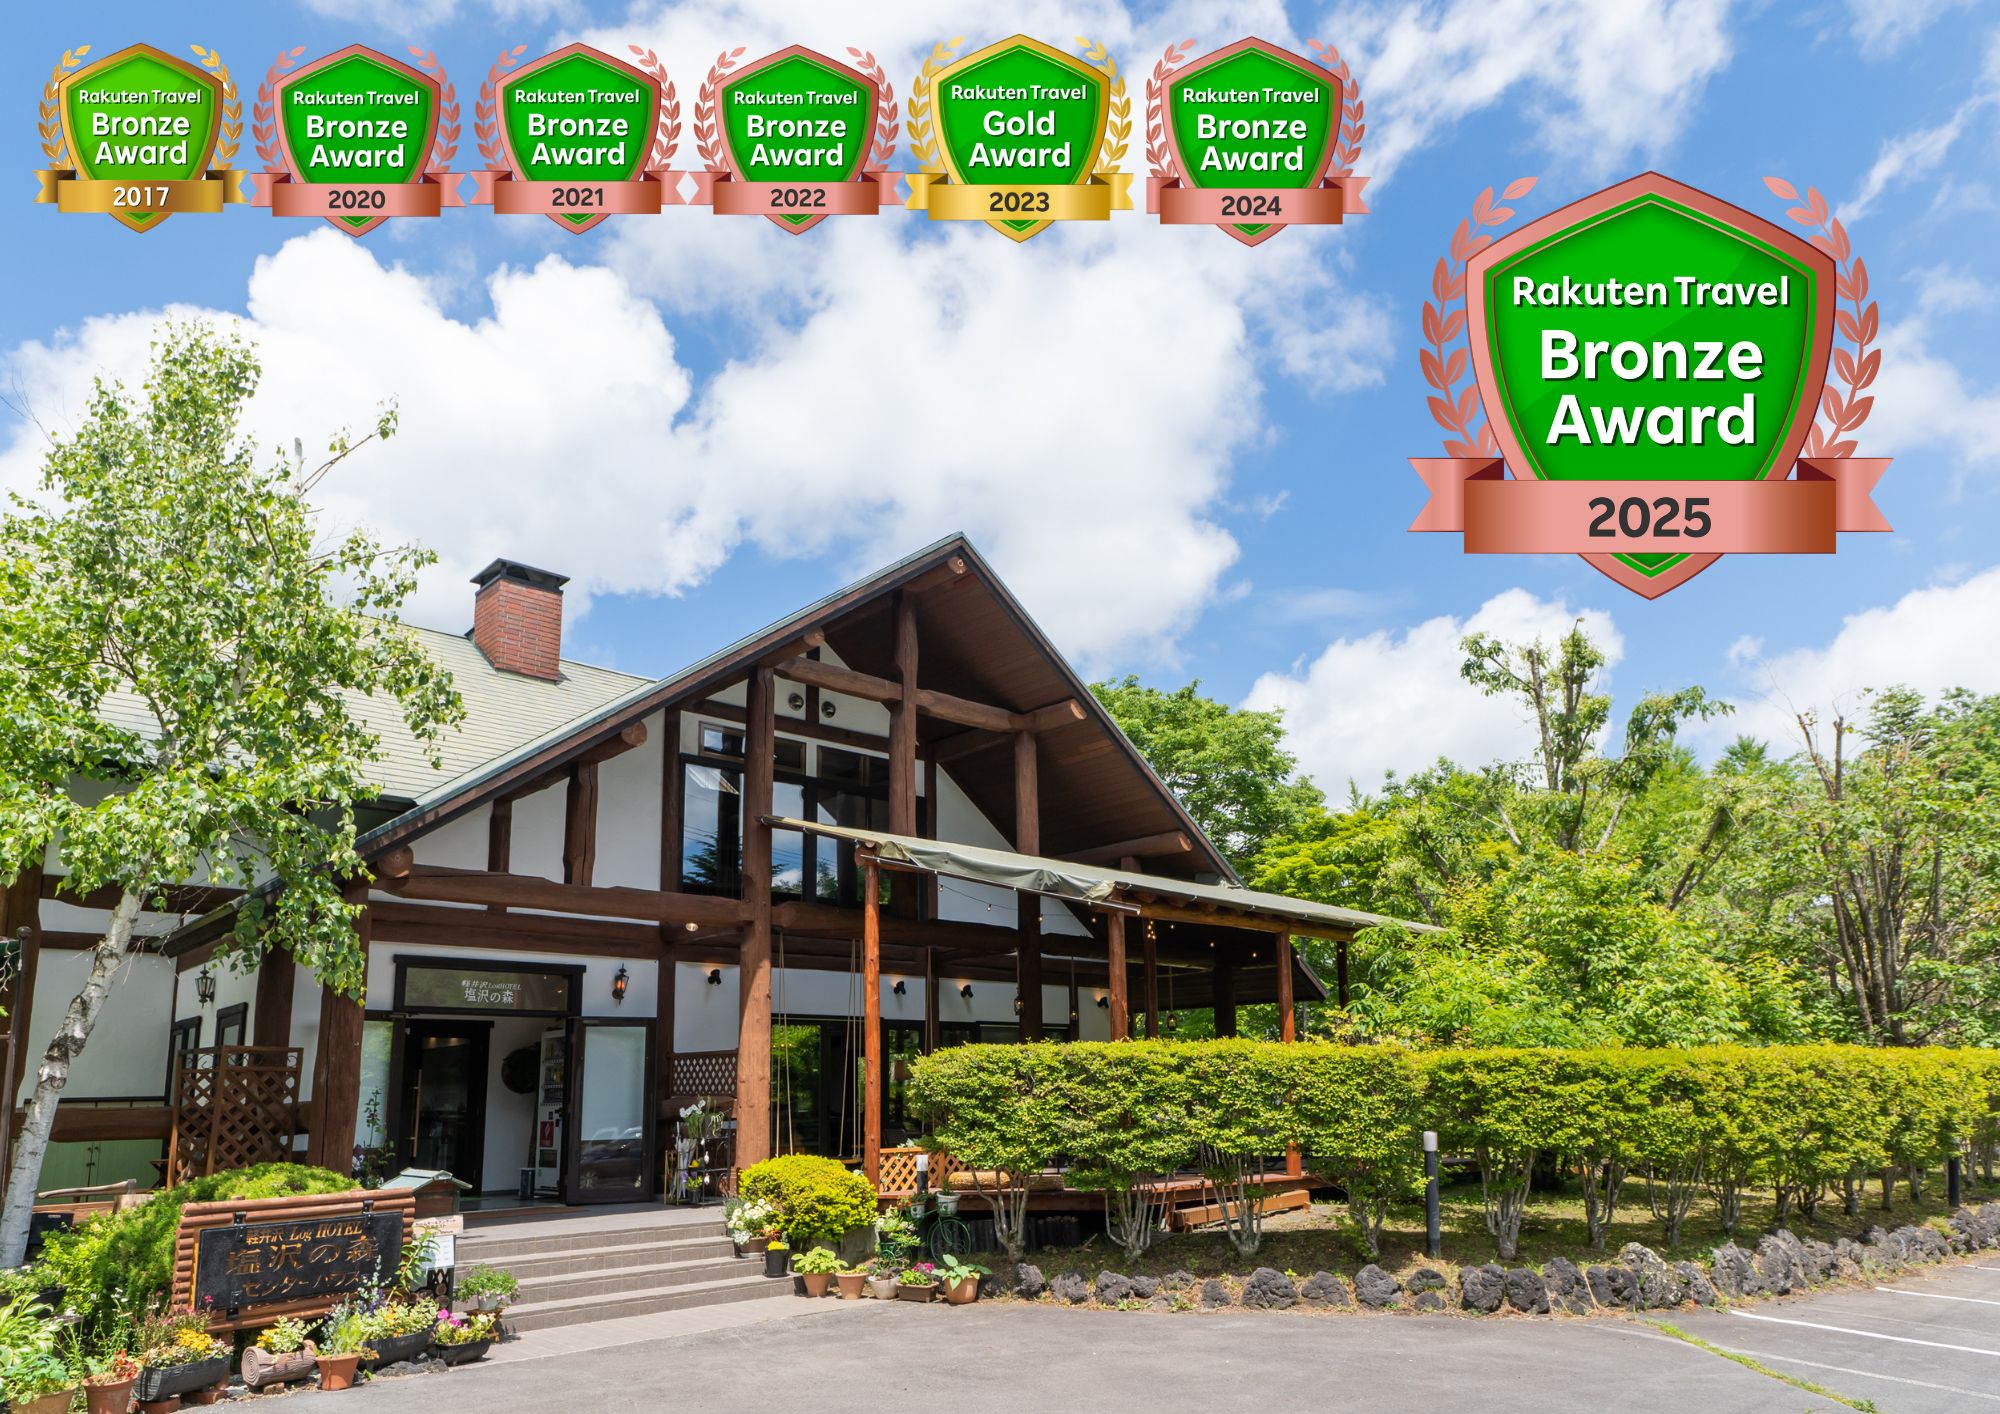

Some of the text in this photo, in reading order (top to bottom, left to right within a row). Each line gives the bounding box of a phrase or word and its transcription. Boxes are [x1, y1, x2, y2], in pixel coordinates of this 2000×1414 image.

[464, 988, 514, 1004] 塩沢の森
[246, 1221, 363, 1245] 軽井沢 Log HOTEL
[225, 1235, 378, 1275] 塩沢の森
[242, 1271, 362, 1297] センターハウス
